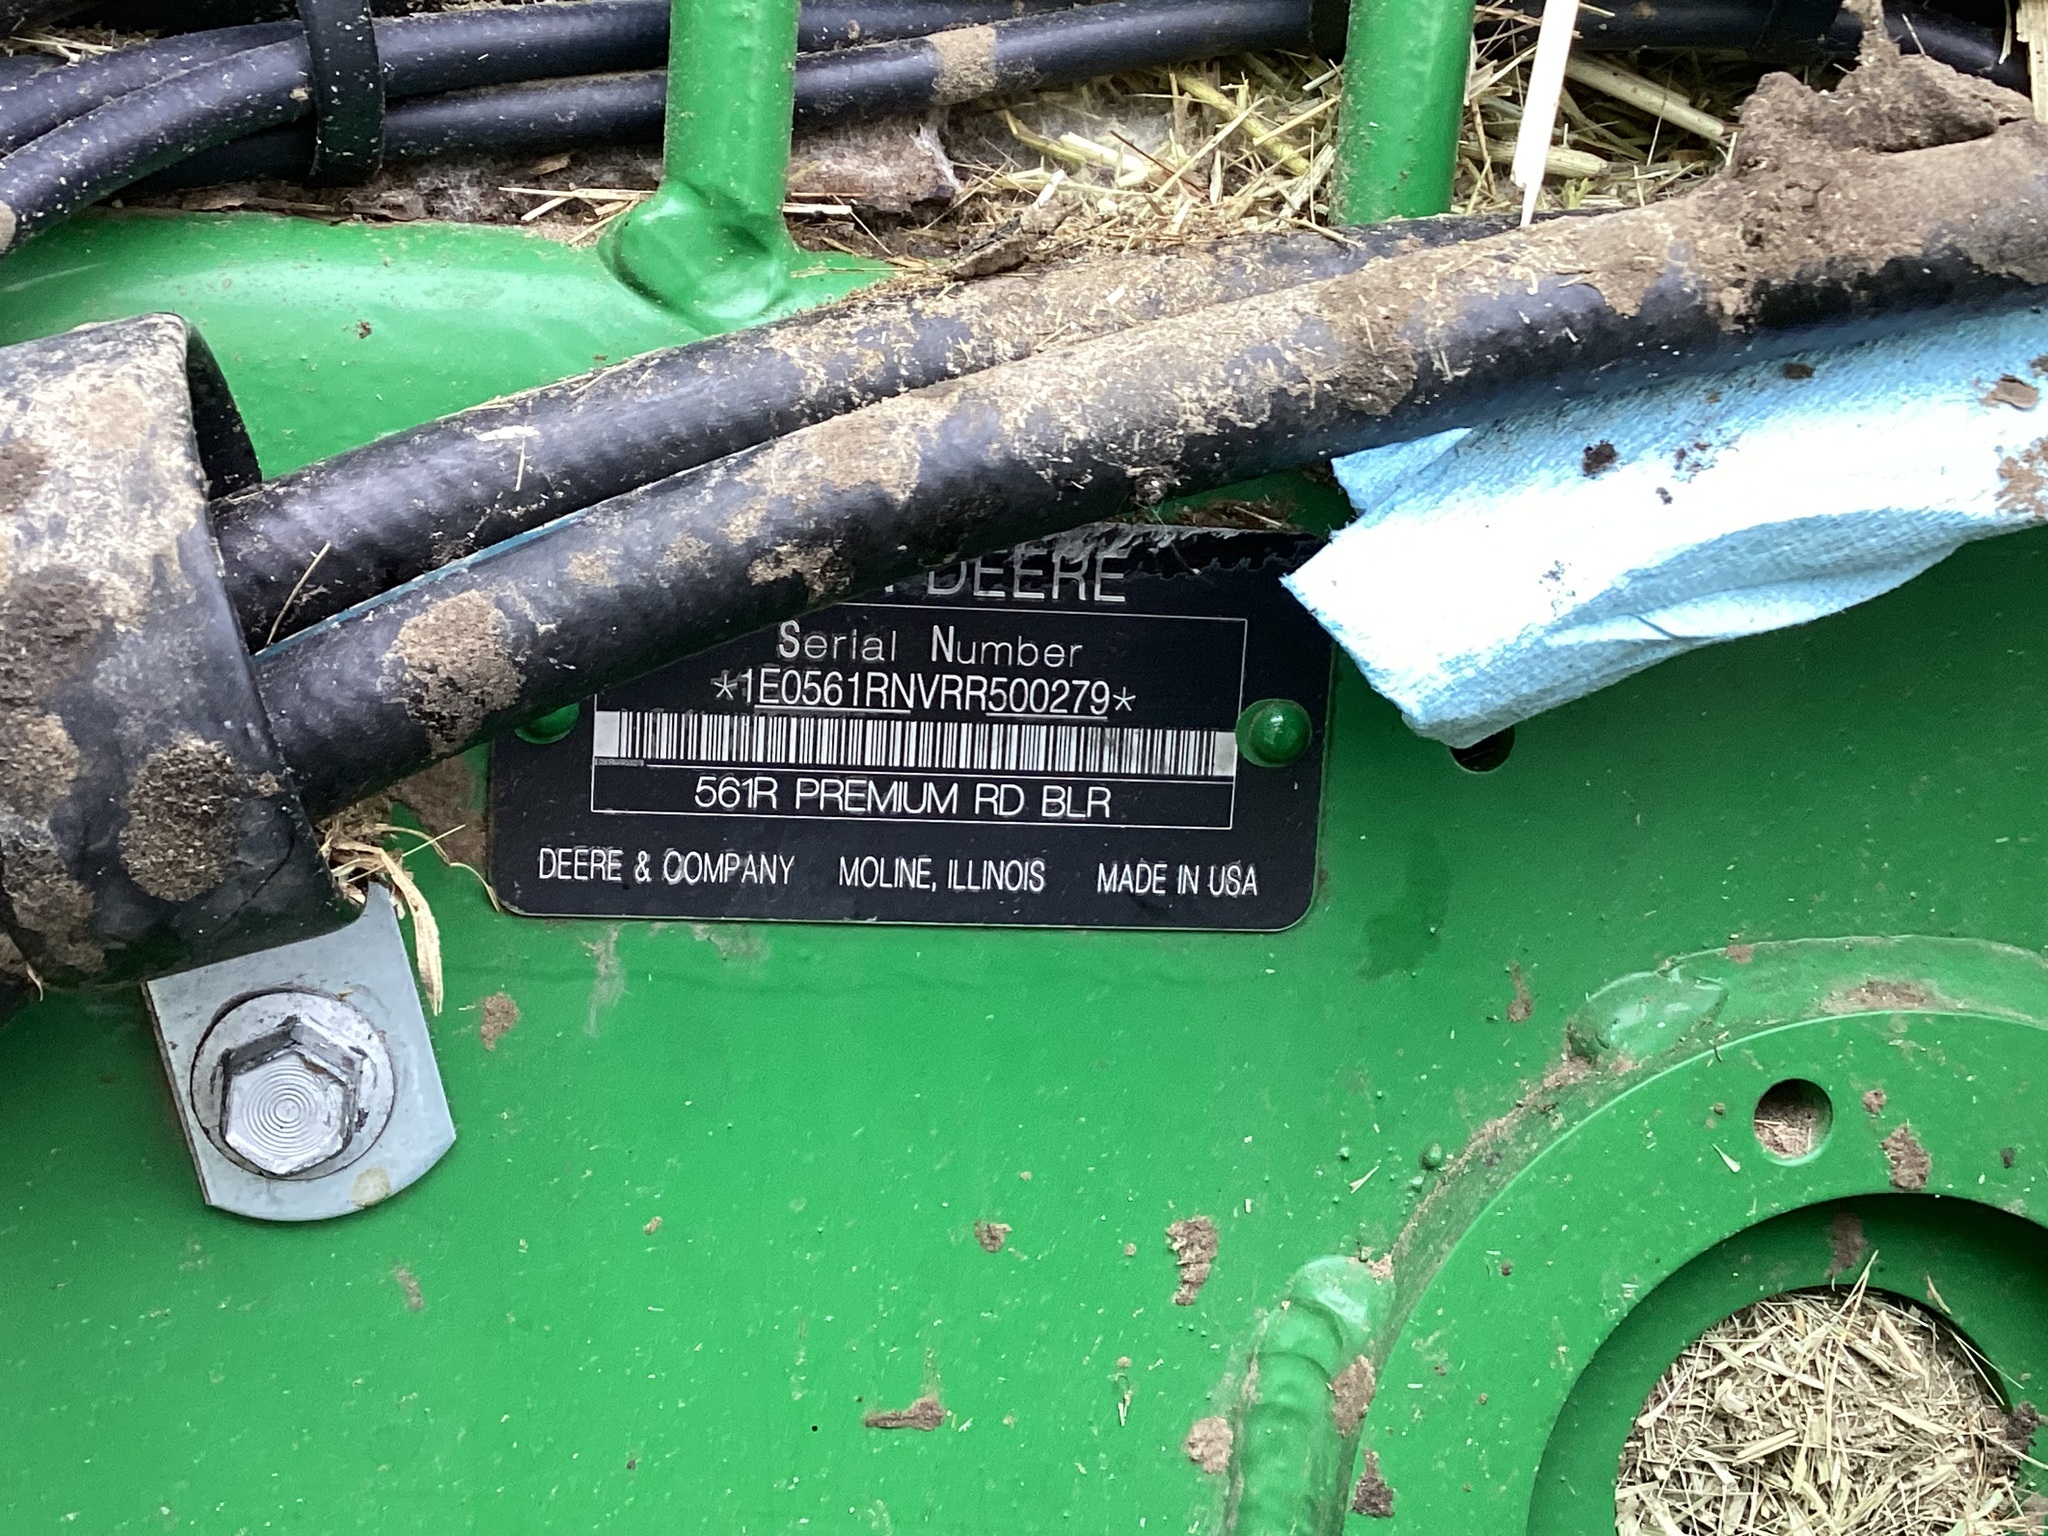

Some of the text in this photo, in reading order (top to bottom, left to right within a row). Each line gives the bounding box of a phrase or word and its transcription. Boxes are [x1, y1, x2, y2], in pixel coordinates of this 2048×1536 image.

[927, 549, 1126, 602] DEERE
[779, 619, 1084, 668] Serial Number
[694, 776, 1111, 819] 561R PREMIUM RD BLR
[539, 847, 795, 885] DEERE & COMPANY
[838, 856, 1046, 893] MOLINE, ILLINOIS
[1097, 862, 1258, 896] MADE IN USA
